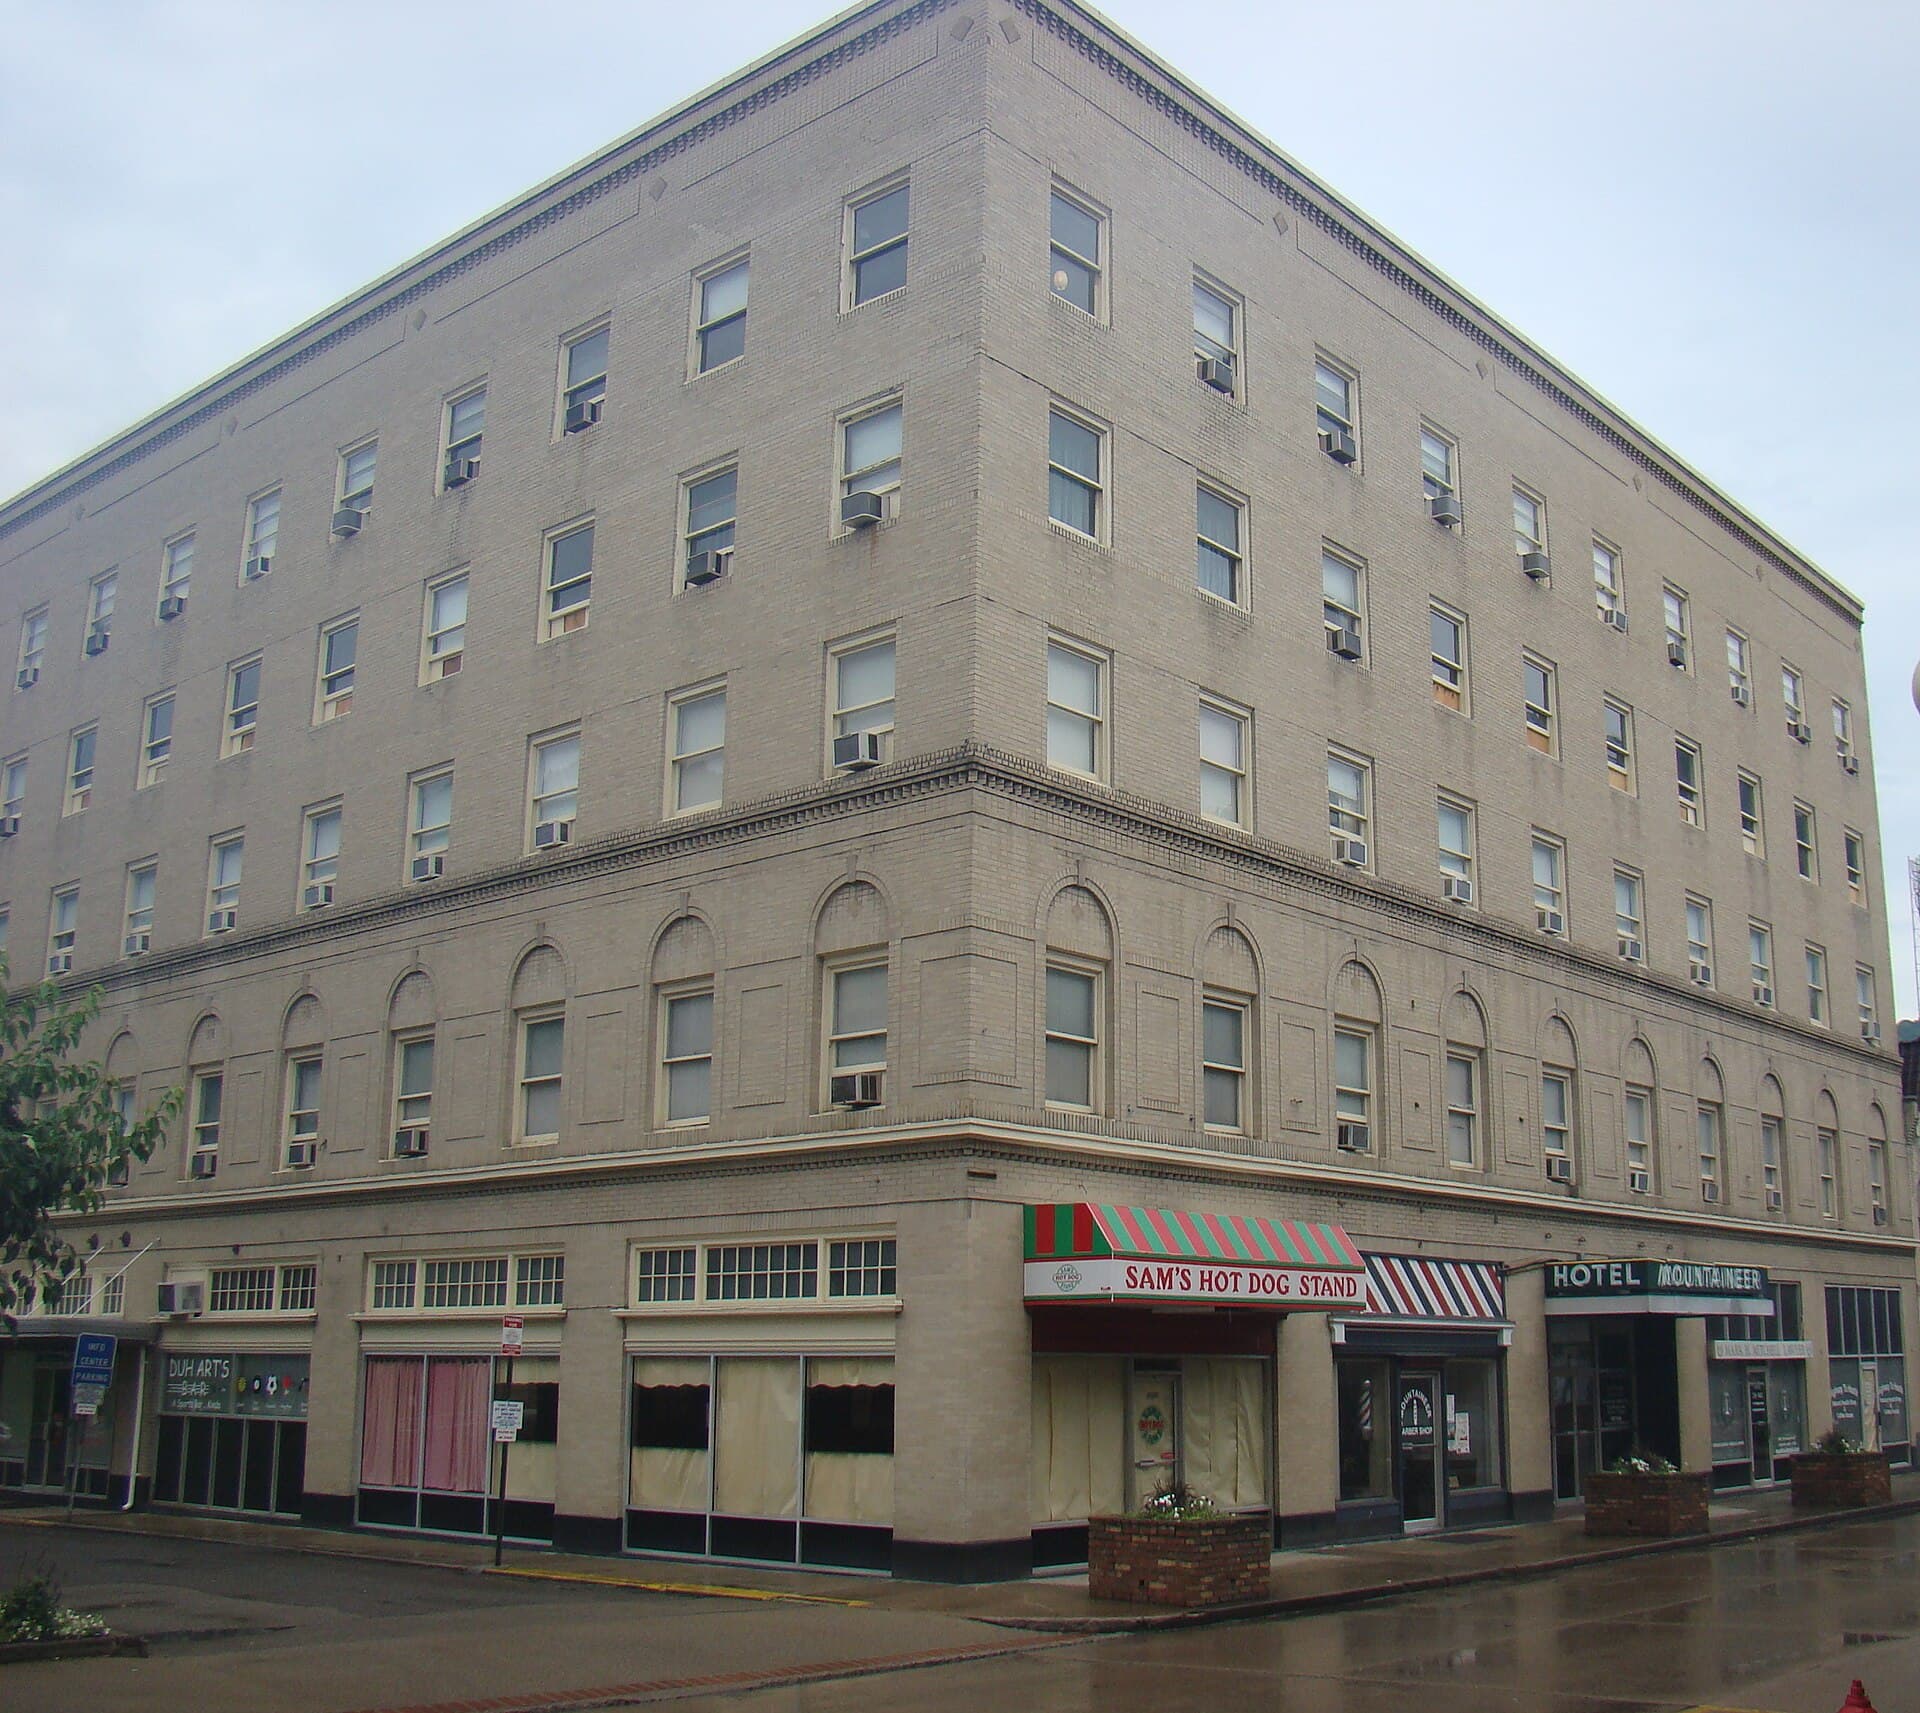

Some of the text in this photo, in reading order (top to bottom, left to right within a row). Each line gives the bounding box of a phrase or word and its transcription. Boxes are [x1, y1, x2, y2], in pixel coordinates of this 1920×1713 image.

[1126, 1266, 1357, 1297] SAM'S HOT DOG STAND
[1553, 1263, 1762, 1290] HOTEL MOUNTAINEER
[80, 1357, 109, 1366] CENTER
[169, 1358, 230, 1378] DUH ART'S
[76, 1372, 110, 1382] PARKING
[181, 1380, 207, 1396] BAR
[1401, 1427, 1418, 1436] ARBER
